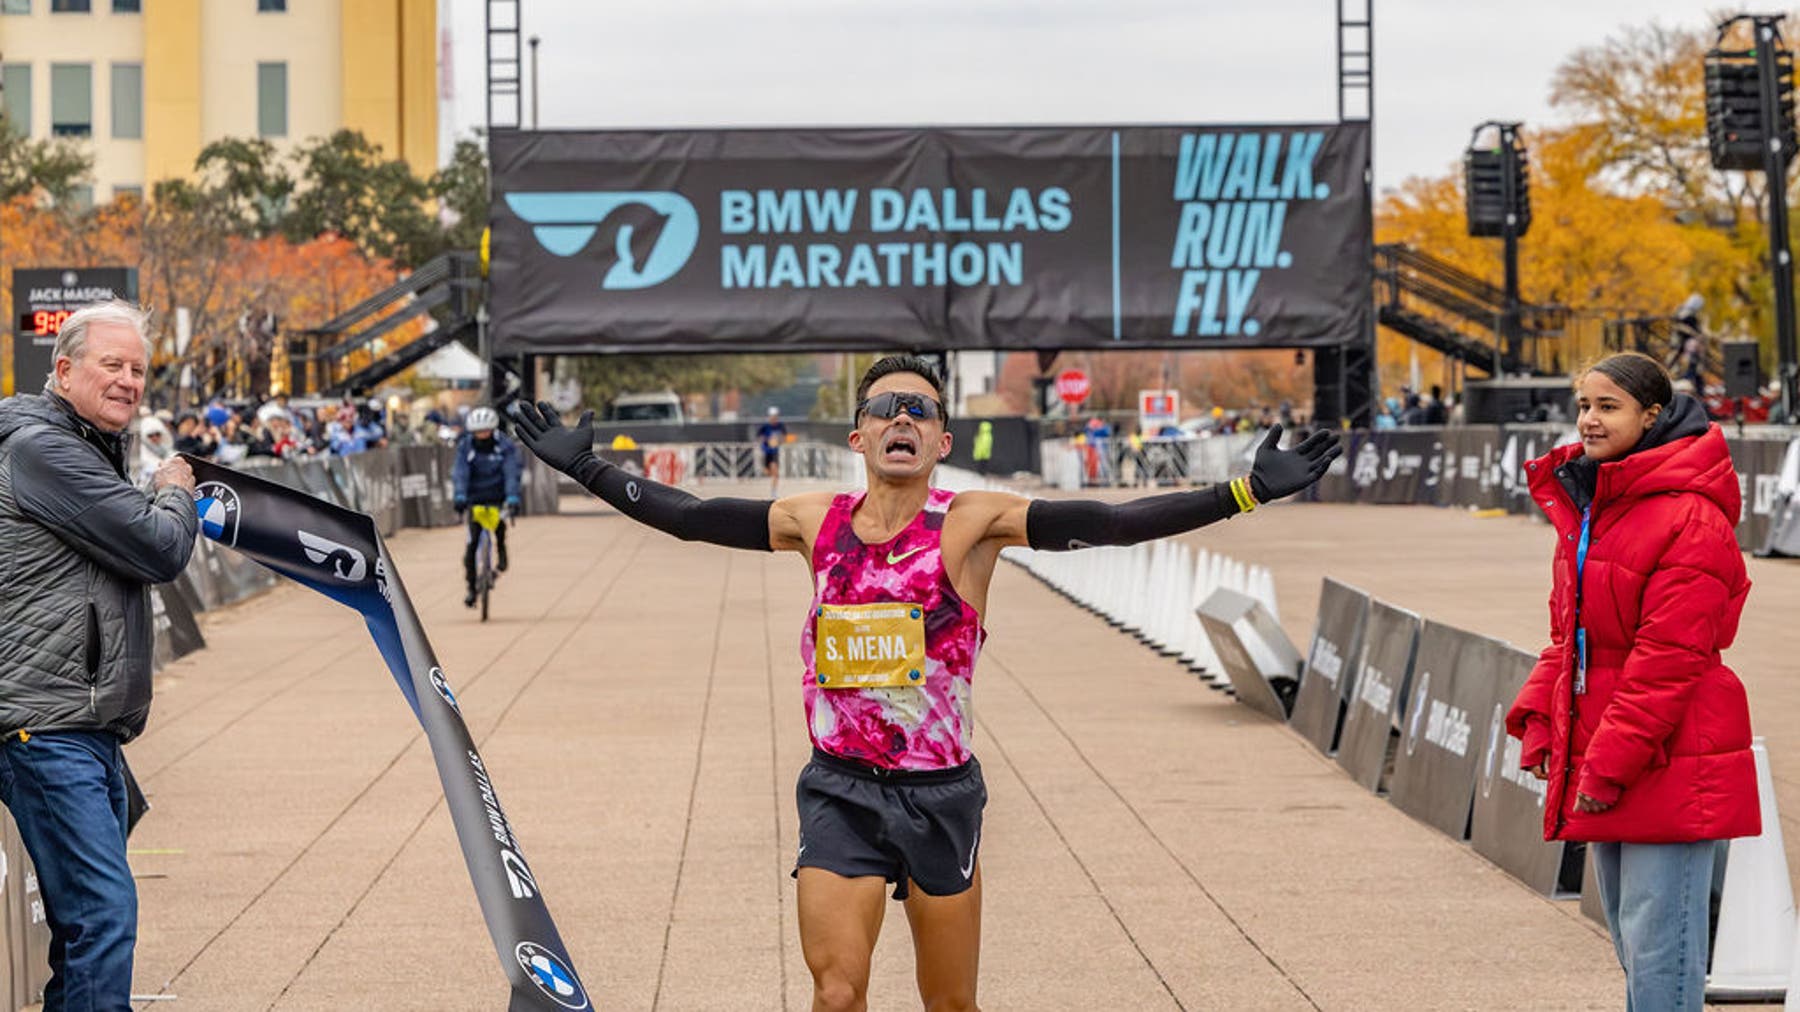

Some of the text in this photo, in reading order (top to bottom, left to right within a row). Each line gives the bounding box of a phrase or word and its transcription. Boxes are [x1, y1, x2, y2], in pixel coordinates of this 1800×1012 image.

[1174, 132, 1330, 201] WALK.
[720, 187, 1072, 233] BMW DALLAS
[1171, 201, 1293, 269] RUN.
[720, 242, 1023, 288] MARATHON
[29, 286, 113, 303] JACK MASON
[1172, 269, 1261, 337] FLY.
[34, 309, 71, 336] 9:0
[1056, 379, 1090, 395] STOP
[825, 635, 907, 661] S. MENA
[467, 750, 500, 809] DALLAS
